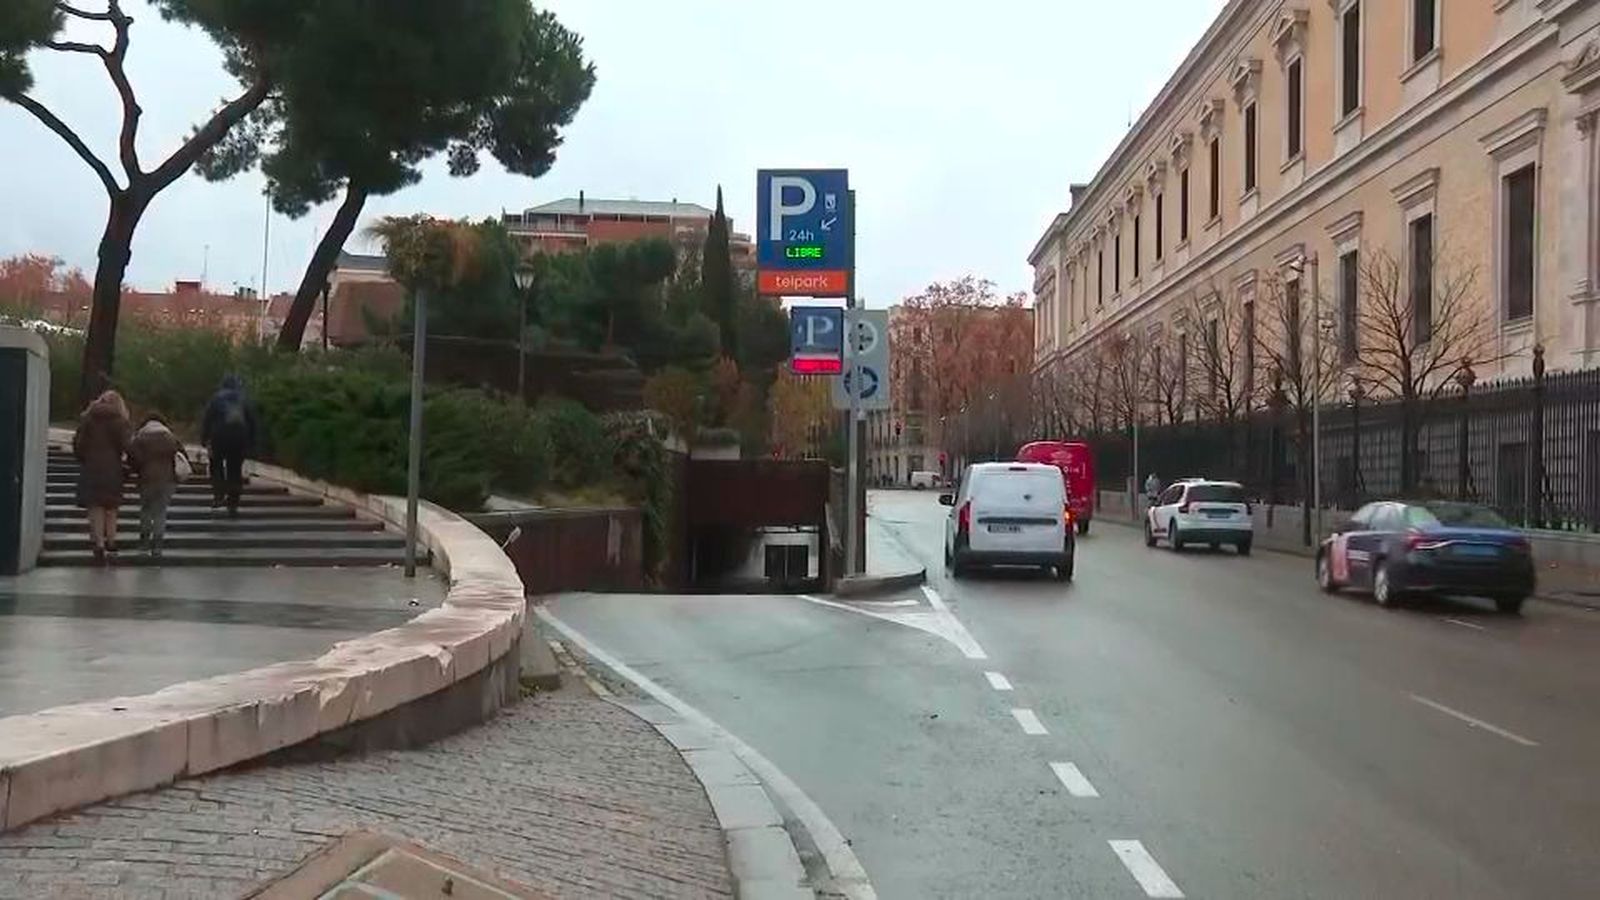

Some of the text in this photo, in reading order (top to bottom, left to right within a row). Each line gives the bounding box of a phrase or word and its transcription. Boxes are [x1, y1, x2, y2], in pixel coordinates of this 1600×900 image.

[770, 176, 817, 241] P
[789, 229, 815, 241] 24h
[785, 247, 822, 258] LIBRE
[775, 275, 829, 290] telpark
[806, 316, 834, 346] P
